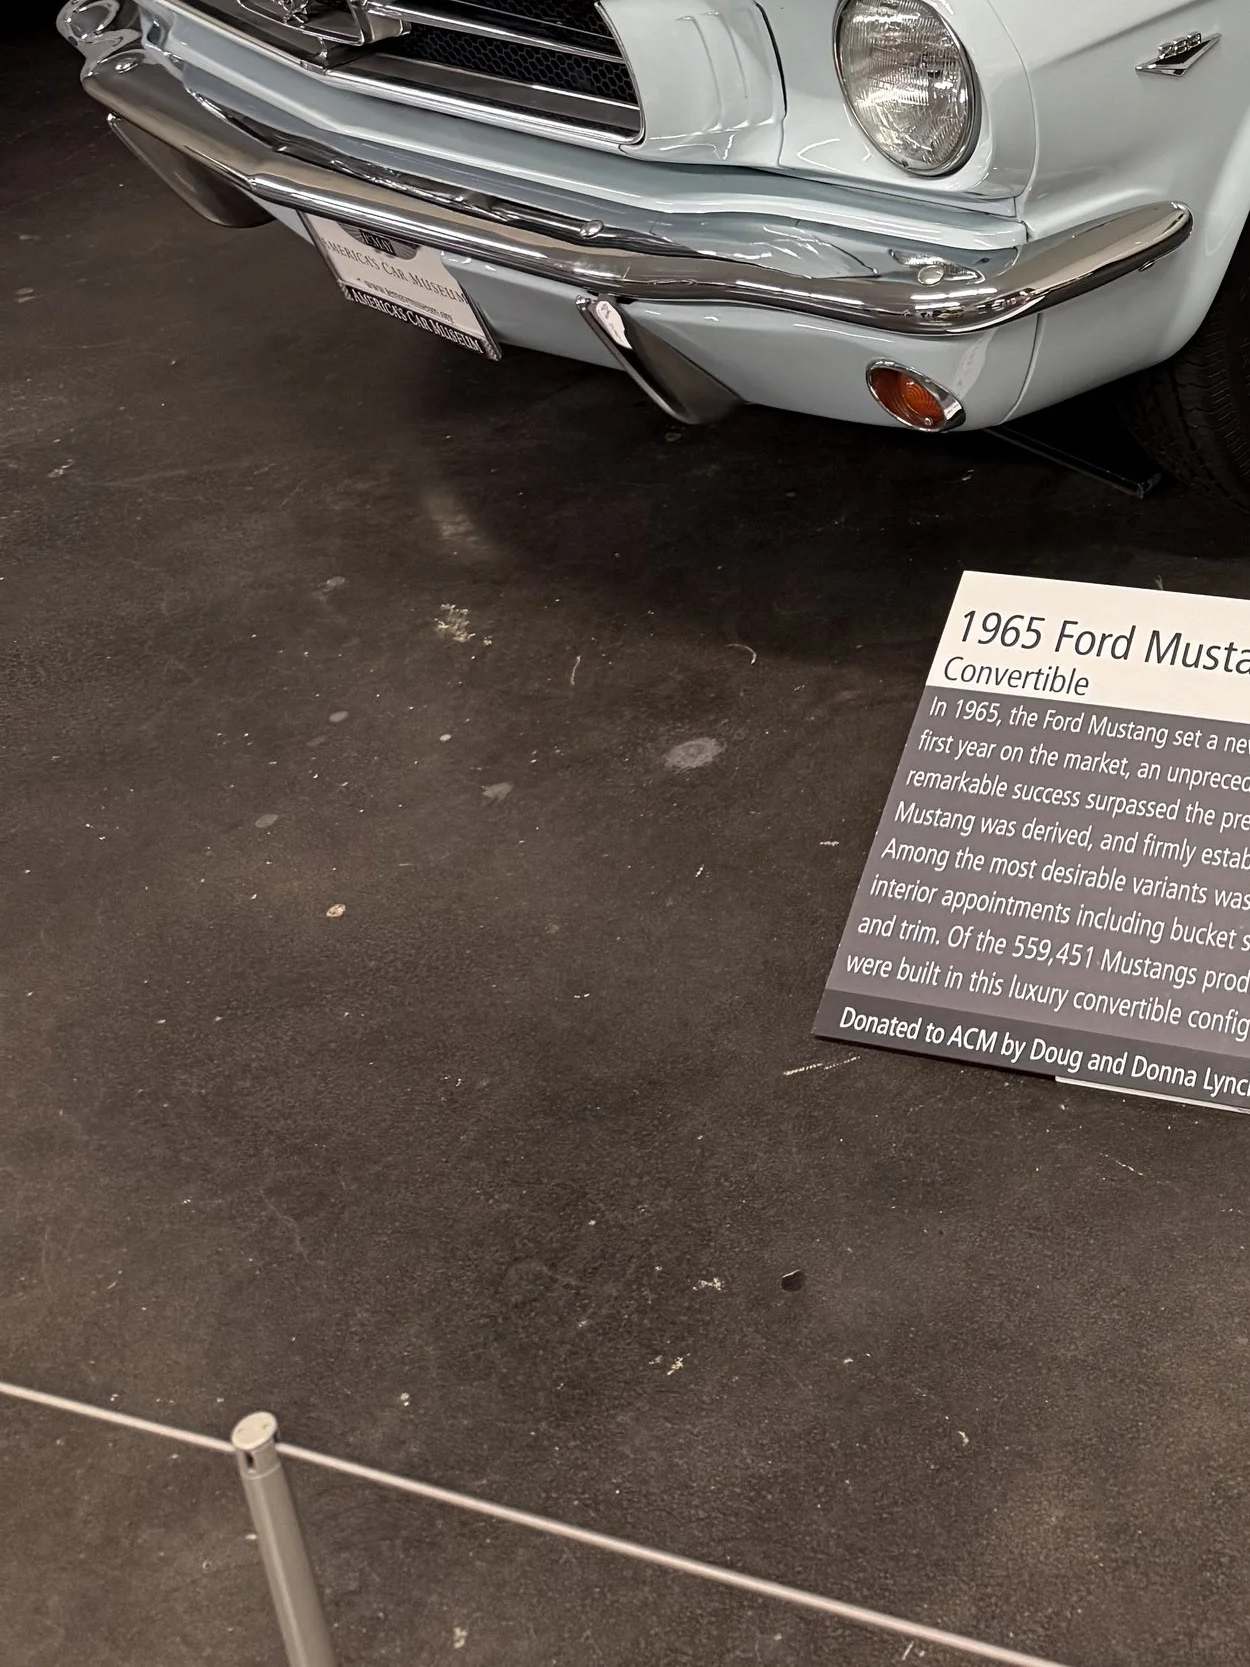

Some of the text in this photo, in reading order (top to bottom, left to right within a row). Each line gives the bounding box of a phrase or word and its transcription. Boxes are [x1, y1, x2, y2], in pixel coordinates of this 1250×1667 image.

[381, 261, 409, 282] CAR
[408, 272, 469, 304] MUSEUM
[351, 289, 484, 354] AMERICA'S CAR MUSEUM
[961, 610, 1046, 650] 1965
[1054, 619, 1137, 661] Ford
[944, 656, 1089, 696] Convertible
[918, 729, 954, 754] first
[954, 739, 997, 761] year
[999, 745, 1024, 763] on
[1029, 743, 1059, 767] the
[1063, 751, 1130, 780] market,
[1137, 762, 1161, 781] an
[929, 696, 947, 717] In
[955, 699, 1002, 727] 1965,
[1009, 704, 1038, 728] the
[1042, 709, 1085, 733] Ford
[1087, 714, 1169, 749] Mustang
[1172, 729, 1203, 749] set
[1206, 734, 1219, 751] a
[905, 769, 1008, 798] remarkable
[1011, 783, 1081, 808] success
[1084, 793, 1181, 821] surpassed
[1185, 801, 1216, 826] the
[894, 800, 976, 837] Mustang
[980, 816, 1017, 837] was
[1021, 817, 1093, 852] derived,
[1099, 831, 1139, 854] and
[1142, 832, 1197, 868] firmly
[880, 837, 951, 872] Among
[954, 846, 985, 872] the
[989, 857, 1038, 879] most
[1041, 858, 1127, 892] desirable
[1133, 875, 1208, 904] variants
[870, 873, 939, 904] interior
[941, 889, 1071, 924] appointments
[1076, 903, 1165, 944] including
[1169, 916, 1237, 950] bucket
[857, 914, 897, 938] and
[899, 919, 940, 945] trim.
[947, 925, 975, 950] Of
[975, 928, 1007, 955] the
[1011, 935, 1094, 969] 559,451
[1100, 948, 1198, 990] Mustangs
[846, 954, 893, 978] were
[896, 956, 942, 986] built
[944, 965, 963, 990] in
[969, 968, 1004, 996] this
[1008, 973, 1070, 1012] luxury
[1073, 991, 1182, 1025] convertible
[839, 1006, 923, 1040] Donated
[925, 1022, 945, 1044] to
[946, 1025, 998, 1053] ACM
[1000, 1031, 1027, 1064] by
[1029, 1038, 1084, 1074] Doug
[1087, 1051, 1128, 1075] and
[1130, 1055, 1197, 1088] Donna
